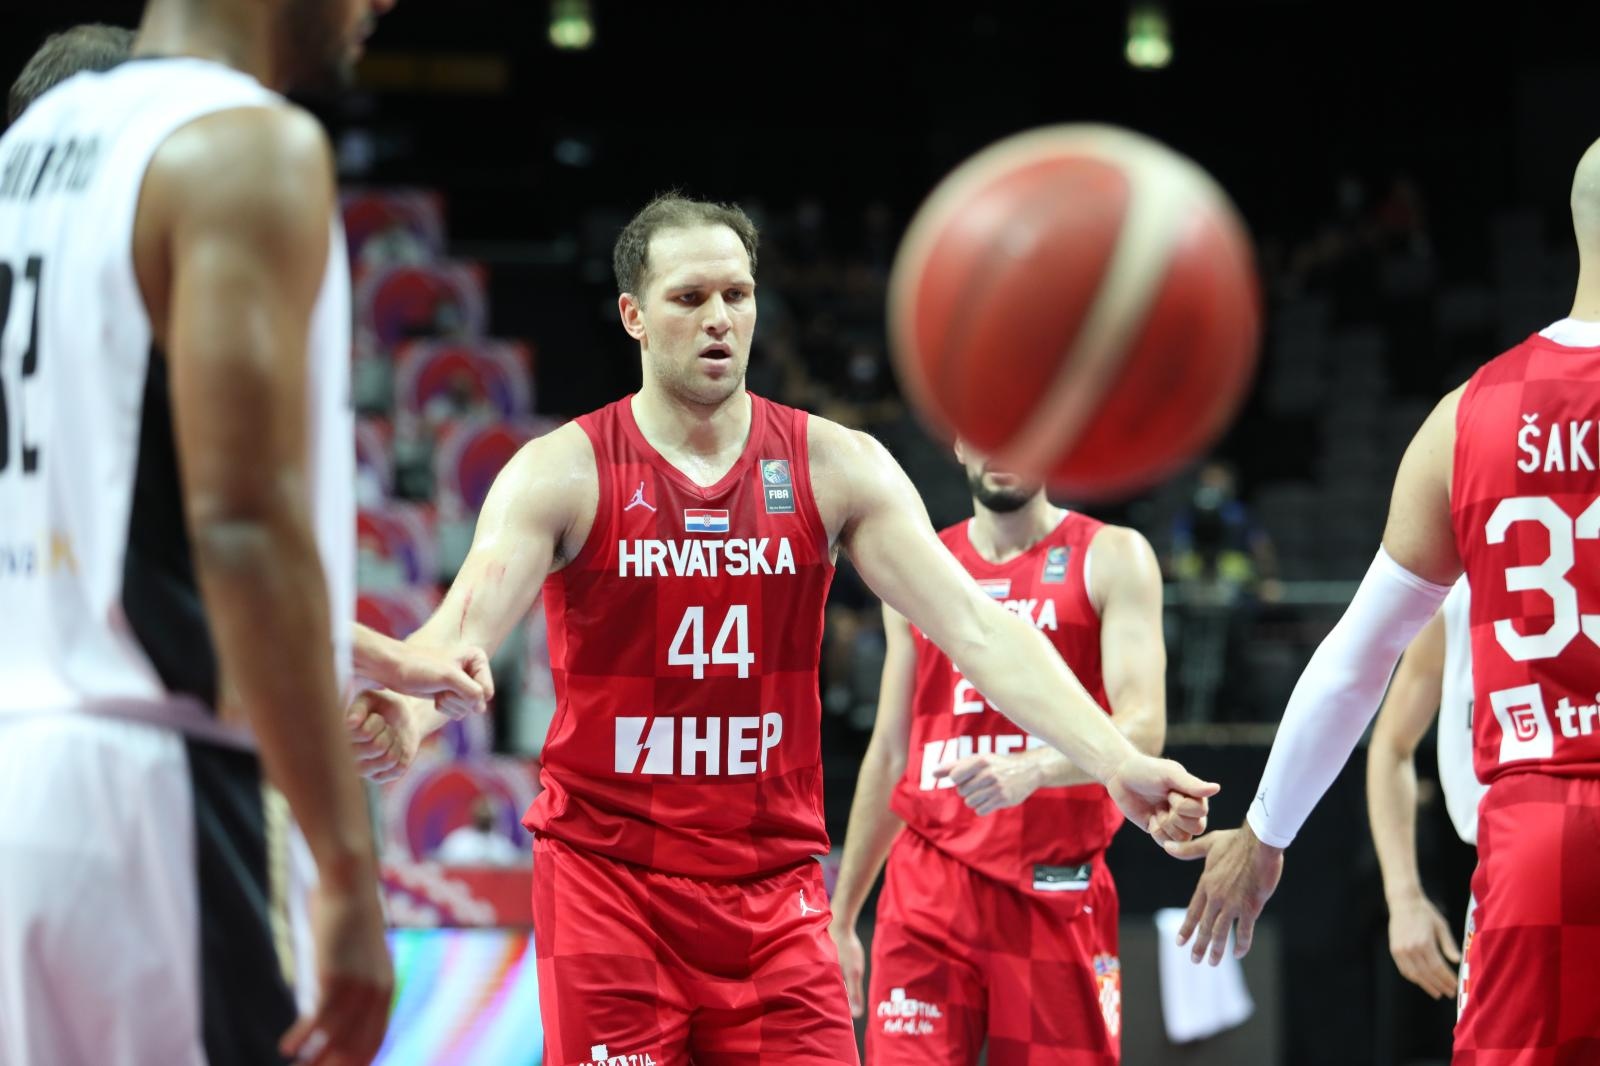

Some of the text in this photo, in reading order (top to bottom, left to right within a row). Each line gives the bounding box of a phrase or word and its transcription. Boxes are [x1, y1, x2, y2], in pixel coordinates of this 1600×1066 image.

[1517, 412, 1600, 474] ŠAK
[768, 489, 789, 500] FIBA
[618, 537, 796, 578] HRVATSKA
[1485, 496, 1600, 663] 3
[667, 604, 755, 680] 44
[681, 712, 783, 777] HEP
